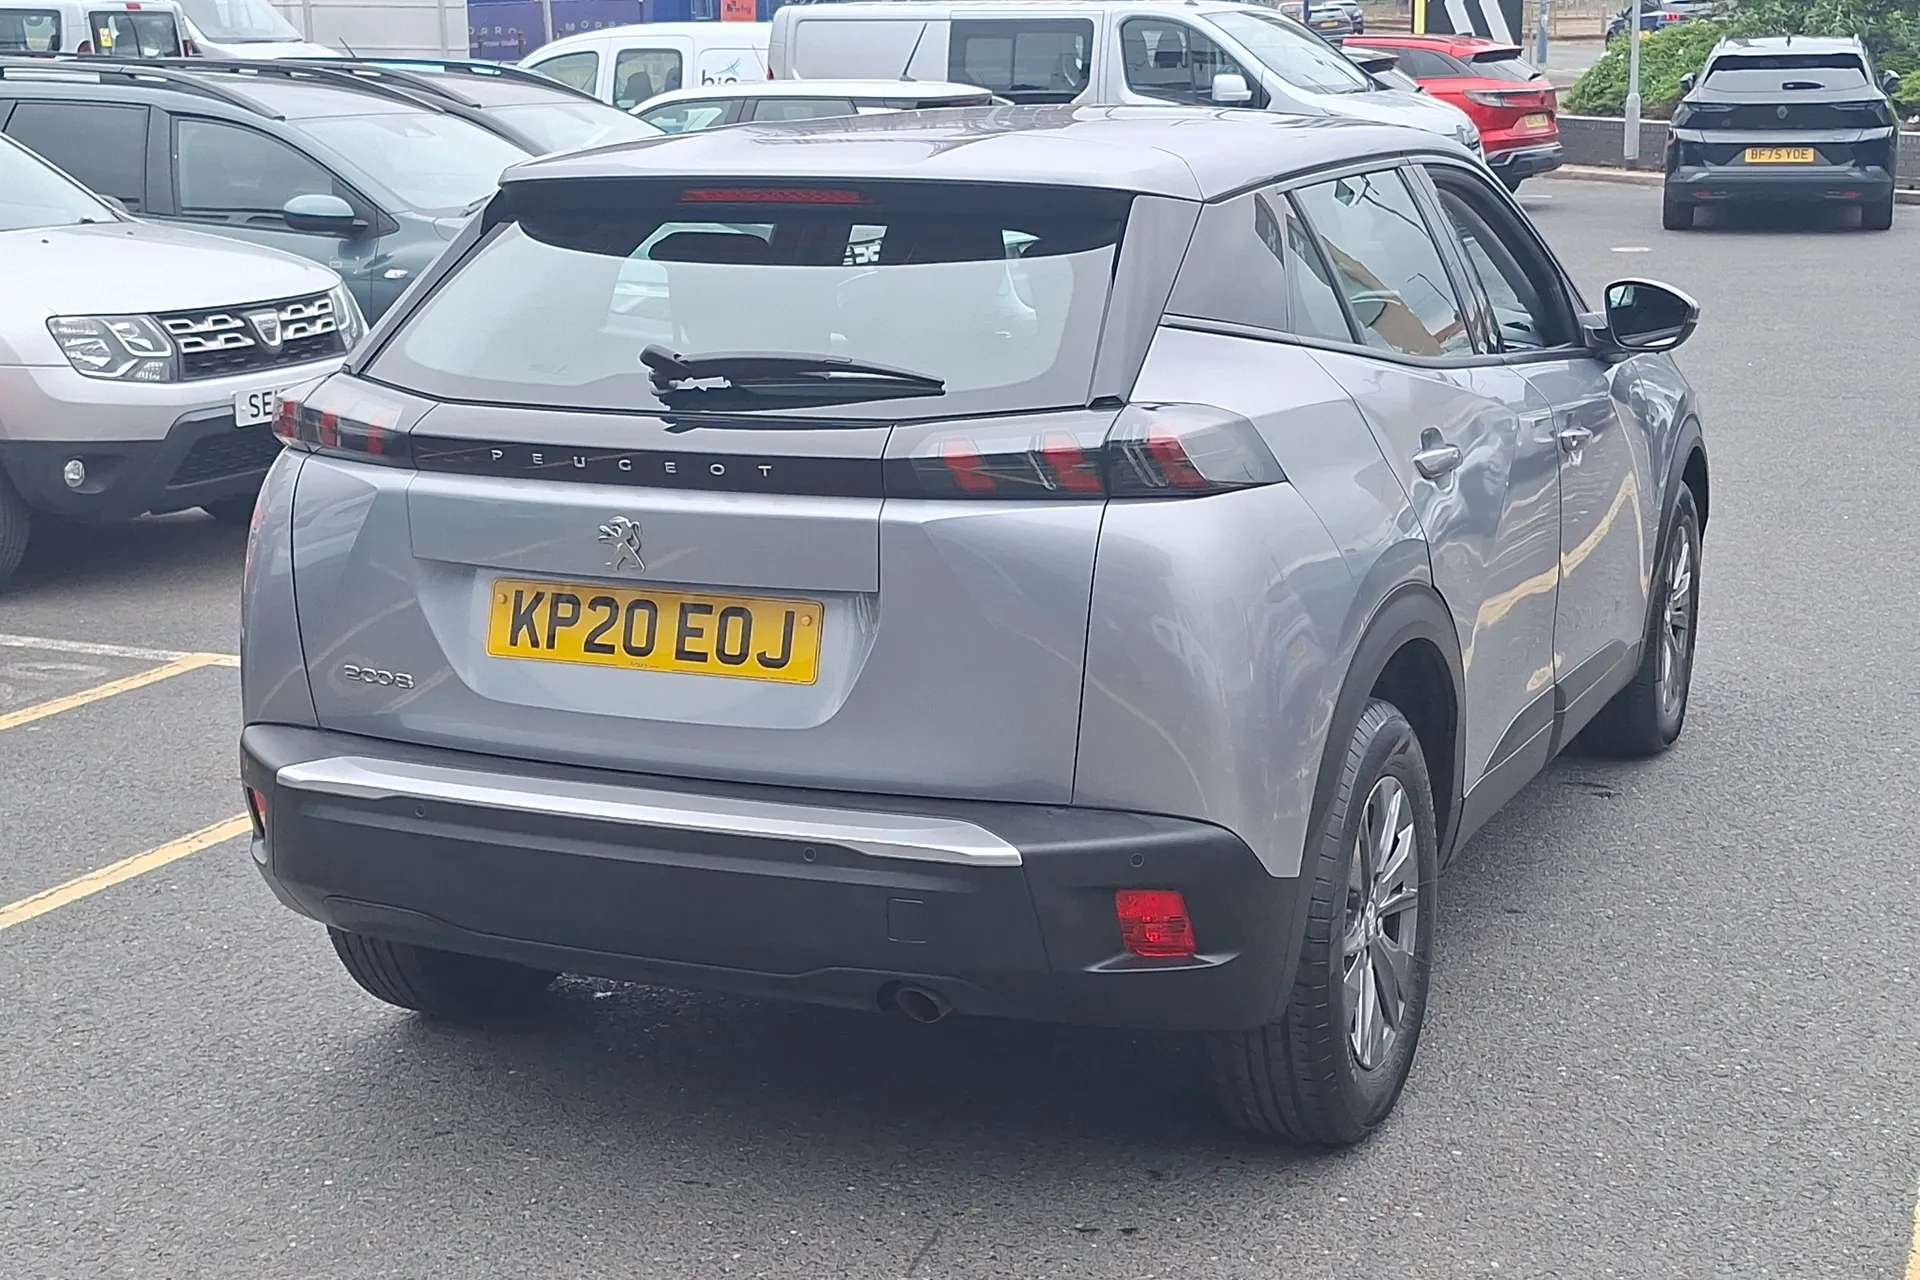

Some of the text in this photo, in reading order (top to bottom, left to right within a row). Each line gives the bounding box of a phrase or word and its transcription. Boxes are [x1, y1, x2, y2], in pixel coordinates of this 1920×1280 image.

[1751, 149, 1809, 160] BF75 YOE
[491, 450, 772, 477] PEUGEOT
[509, 590, 795, 669] KP20 EOJ
[344, 664, 415, 689] 2008
